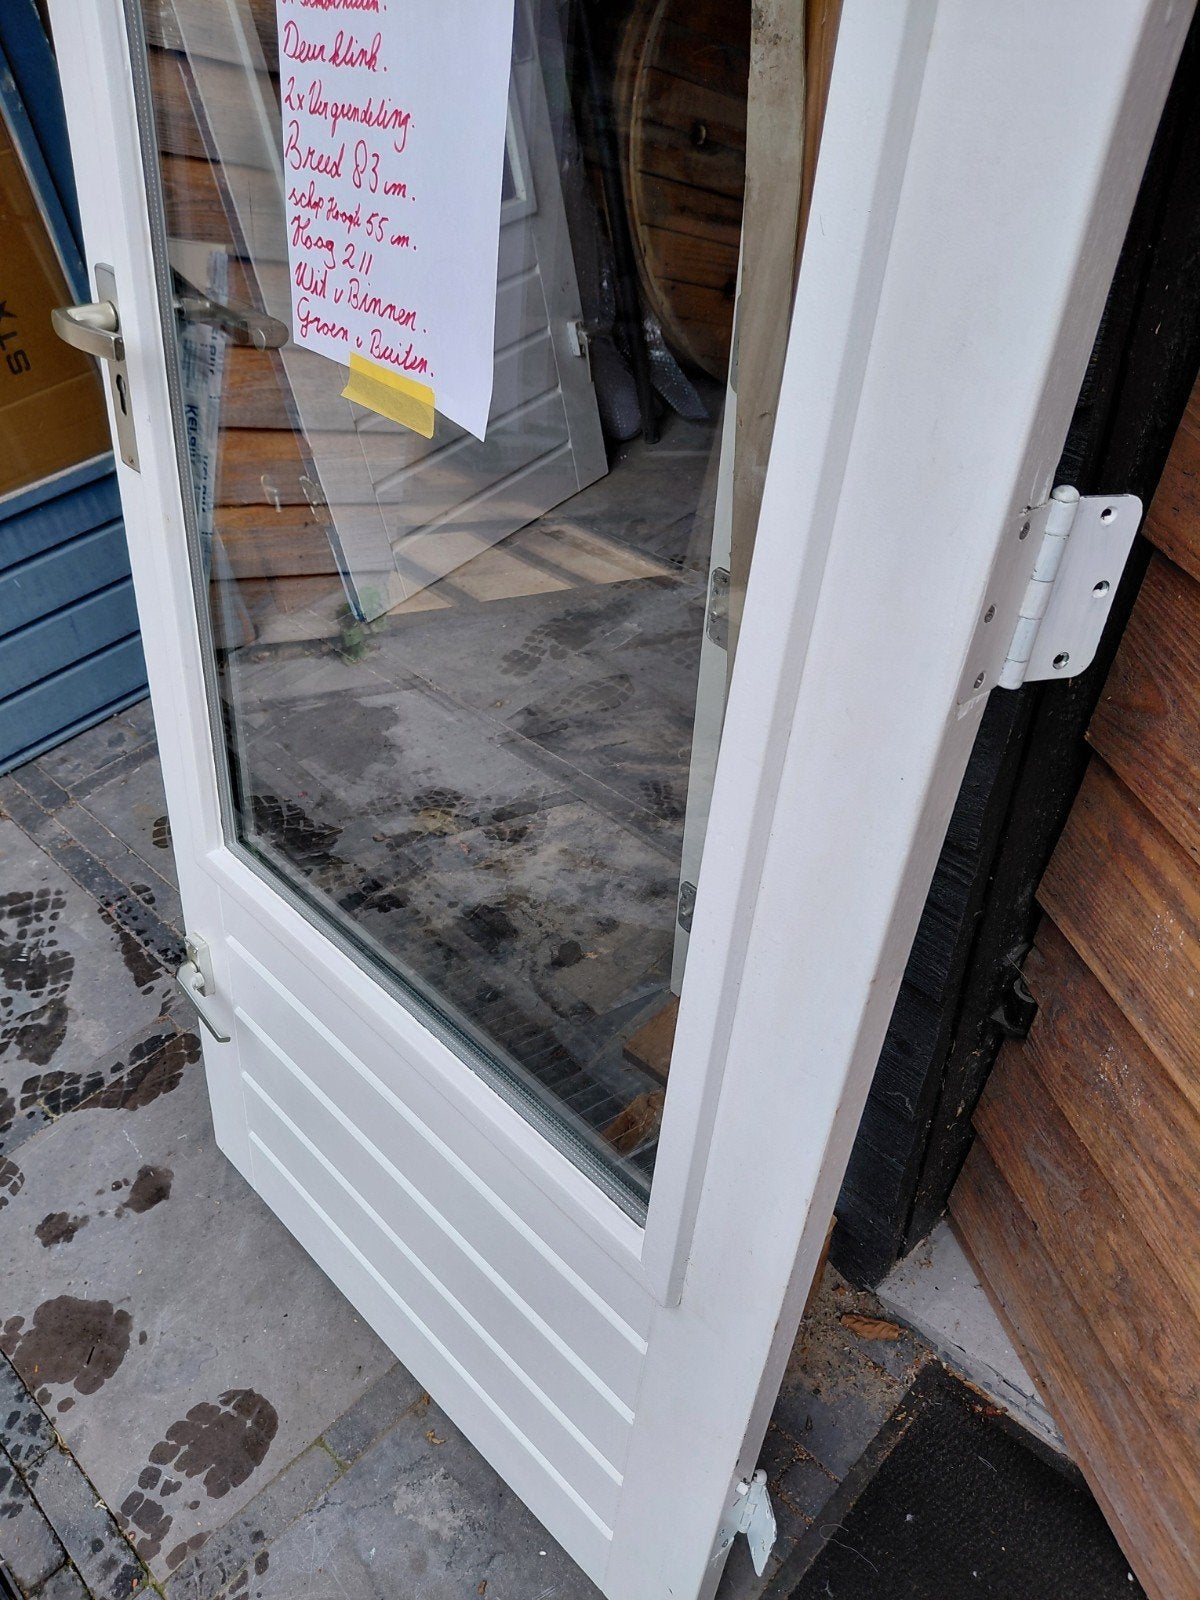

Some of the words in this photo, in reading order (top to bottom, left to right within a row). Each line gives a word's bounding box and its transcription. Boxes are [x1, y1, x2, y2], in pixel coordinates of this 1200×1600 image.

[285, 119, 345, 178] Breed
[352, 139, 380, 193] 83
[290, 214, 336, 270] Hoog
[342, 243, 373, 275] 211
[365, 212, 389, 242] 55
[294, 261, 328, 299] Wit
[348, 277, 426, 333] Binnen.
[295, 296, 349, 342] Groen
